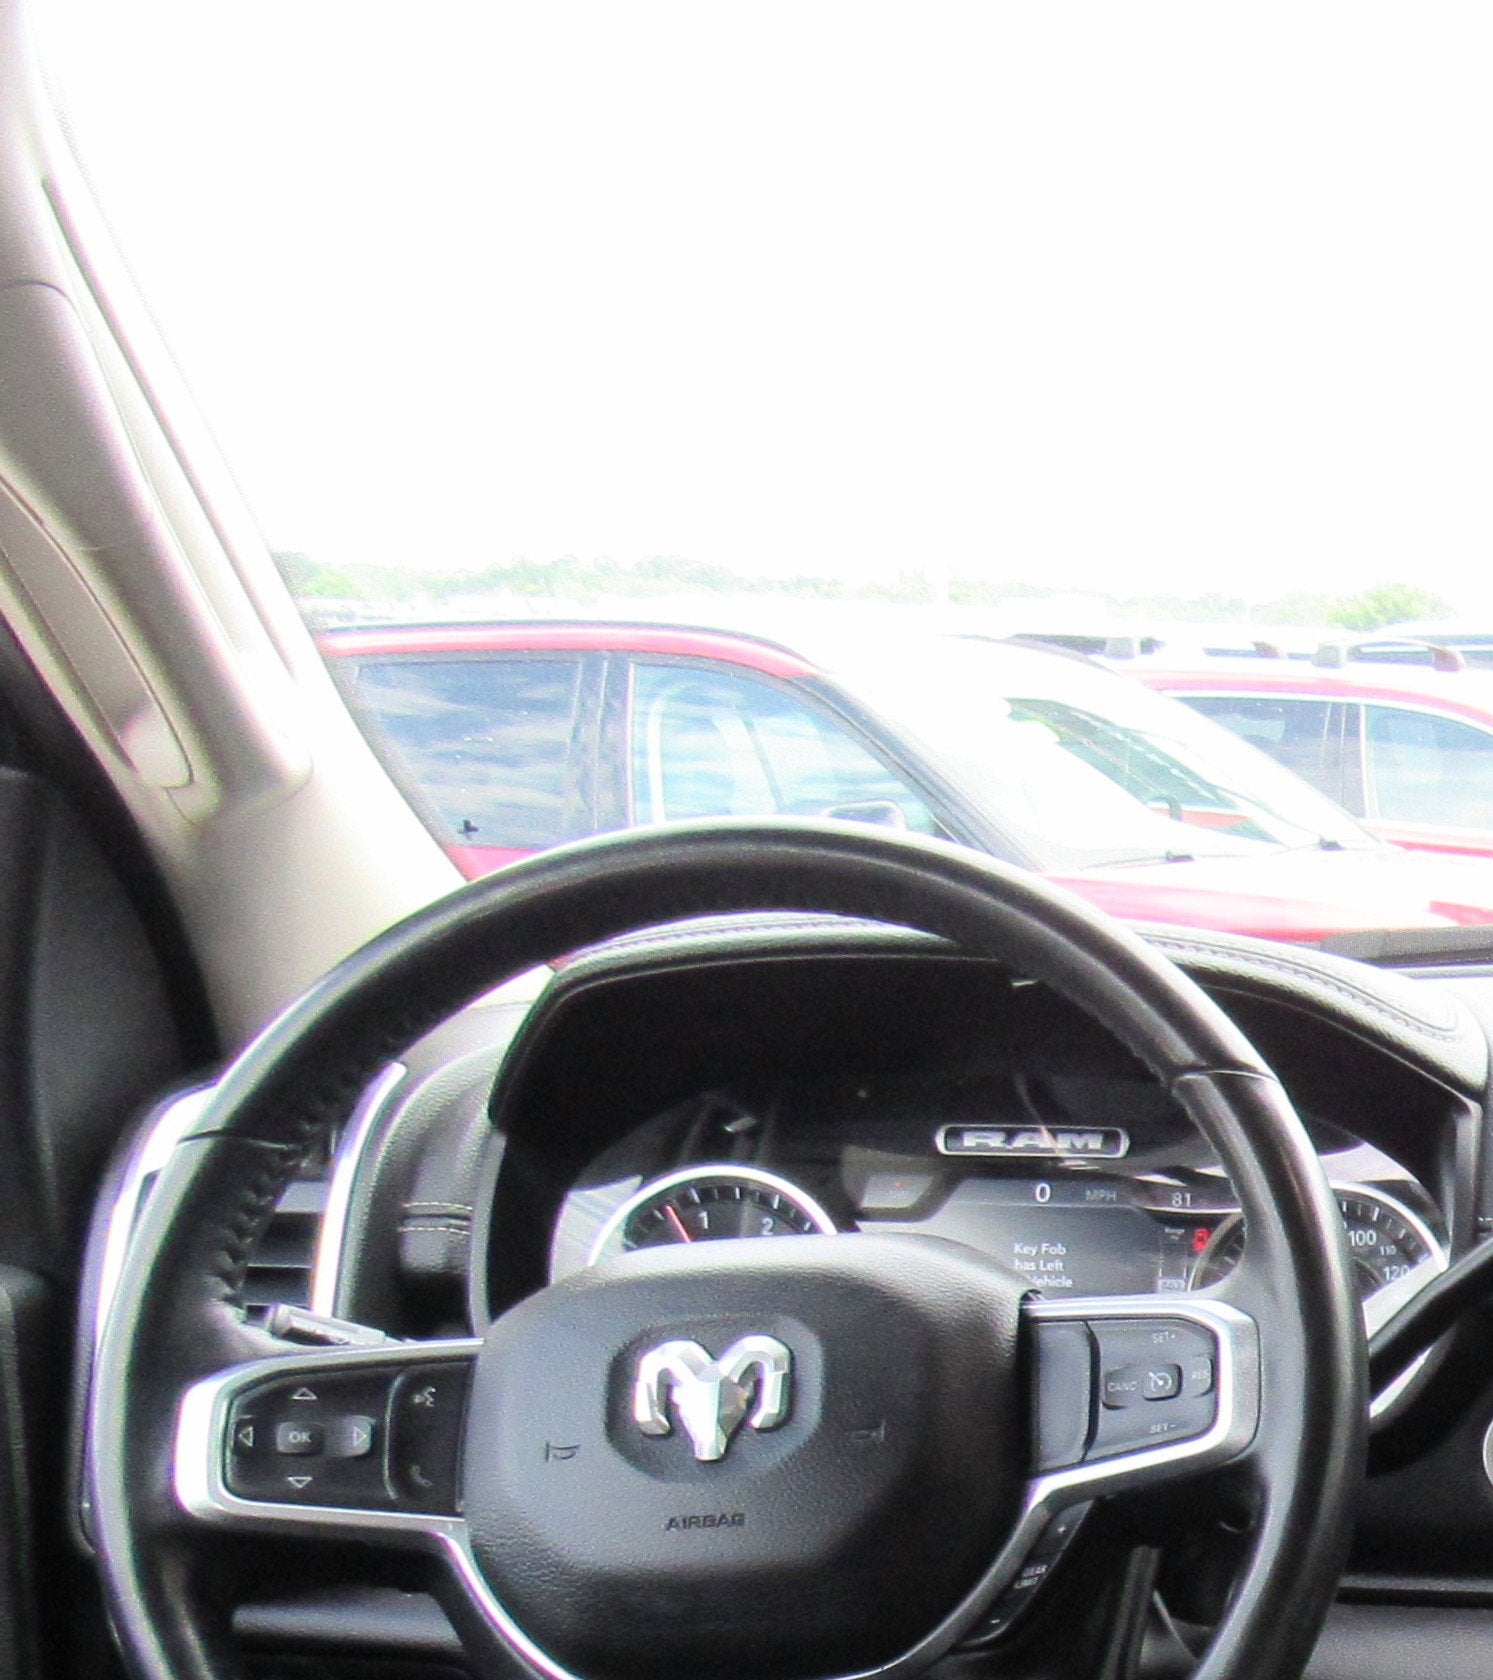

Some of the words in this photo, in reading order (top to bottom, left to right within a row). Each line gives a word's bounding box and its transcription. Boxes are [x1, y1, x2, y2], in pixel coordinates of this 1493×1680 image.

[961, 1130, 1103, 1150] RAM
[1034, 1183, 1051, 1203] 0
[1085, 1188, 1117, 1202] MPH
[1171, 1191, 1192, 1208] 81
[699, 1211, 709, 1229] 1
[761, 1217, 774, 1236] 2
[1348, 1229, 1377, 1247] 100
[1014, 1242, 1038, 1257] Key
[1041, 1242, 1067, 1256] Fob
[1014, 1258, 1036, 1271] has
[1040, 1258, 1064, 1272] Left
[1383, 1265, 1410, 1280] 120
[289, 1431, 312, 1443] OK
[664, 1512, 745, 1532] AIRBAG
